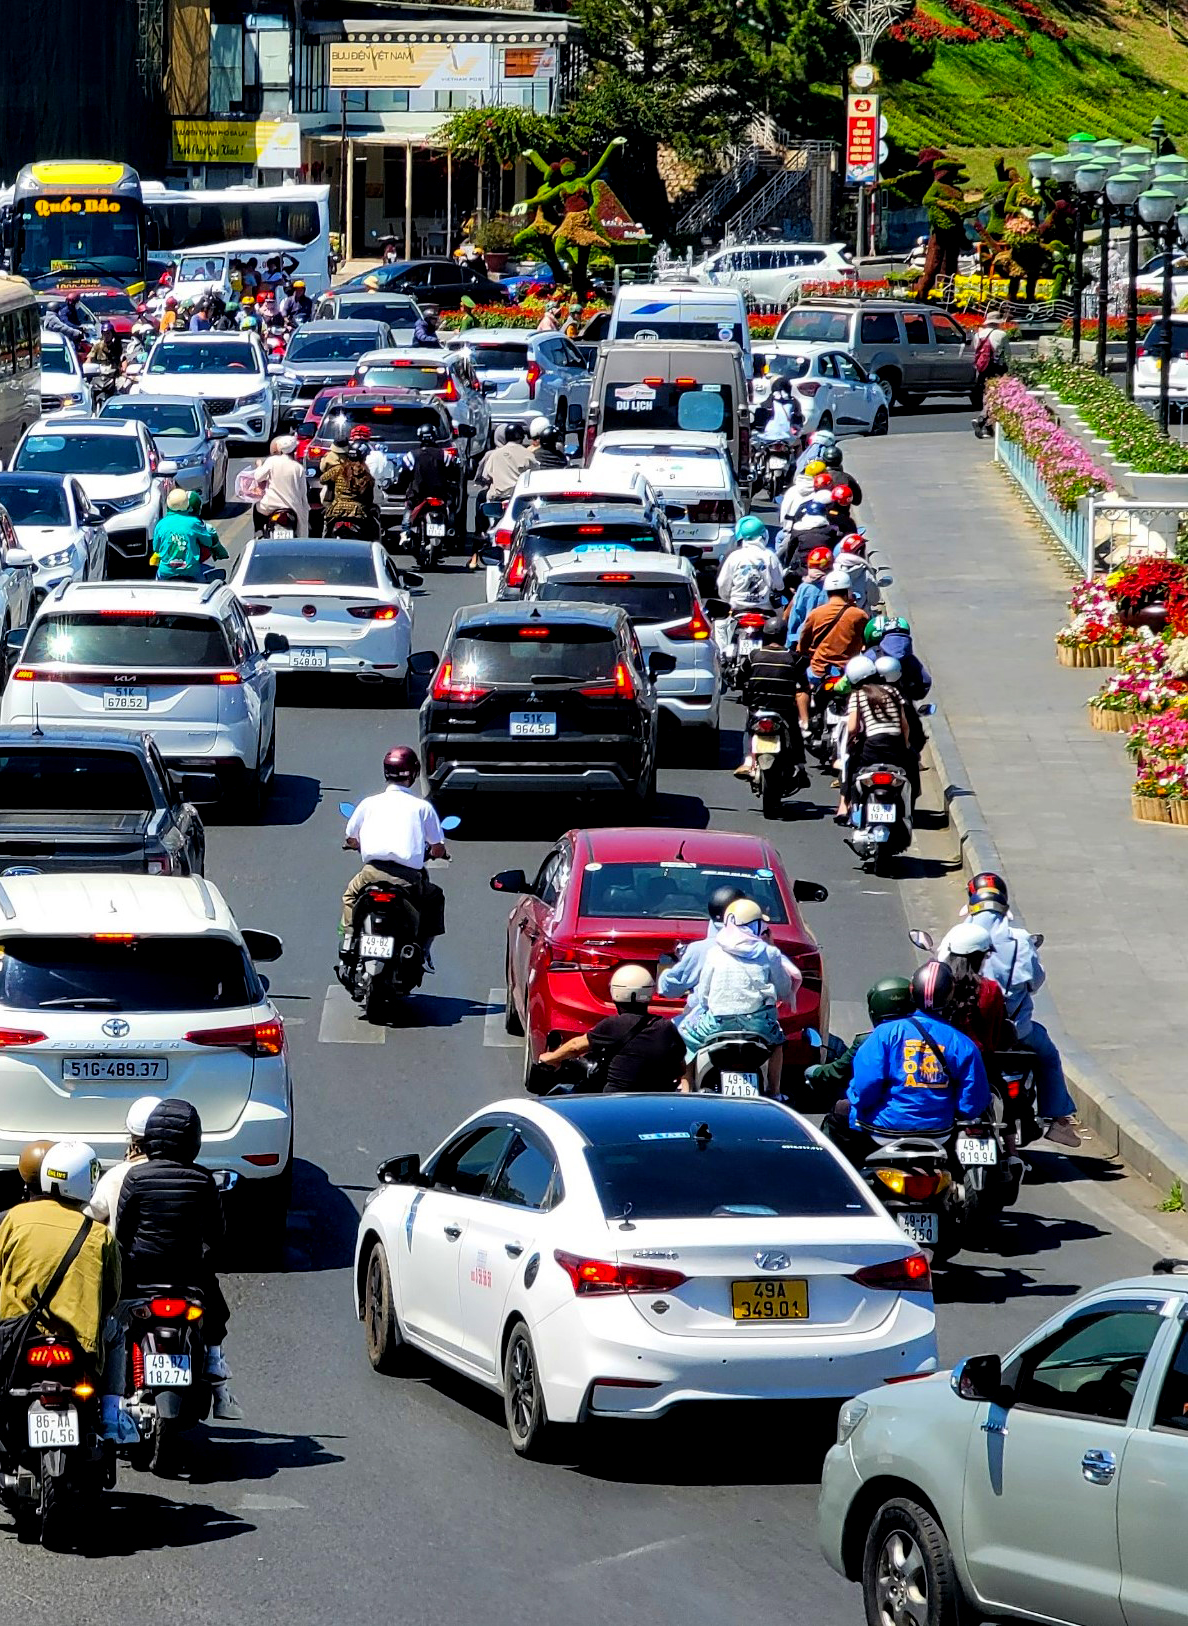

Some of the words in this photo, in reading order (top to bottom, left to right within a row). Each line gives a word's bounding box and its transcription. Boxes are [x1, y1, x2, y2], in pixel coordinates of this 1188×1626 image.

[34, 196, 82, 217] Quốc
[84, 198, 121, 213] Bảo
[616, 401, 629, 411] DU
[632, 400, 653, 412] LỊCH
[300, 648, 316, 657] 49A
[293, 658, 323, 667] 548.03
[115, 687, 134, 697] 51K
[108, 697, 143, 708] 678.52
[523, 714, 543, 723] 51K
[515, 724, 551, 734] 964.56
[48, 1041, 180, 1050] FORTUNER
[71, 1061, 160, 1077] 51G-489.37
[960, 1151, 995, 1164] 819.94
[904, 1213, 932, 1227] 49-P1
[754, 1282, 786, 1298] 49A
[741, 1301, 799, 1318] 349.01
[150, 1370, 188, 1386] 182.74
[36, 1414, 70, 1428] 86-AA
[34, 1429, 75, 1445] 104.56
